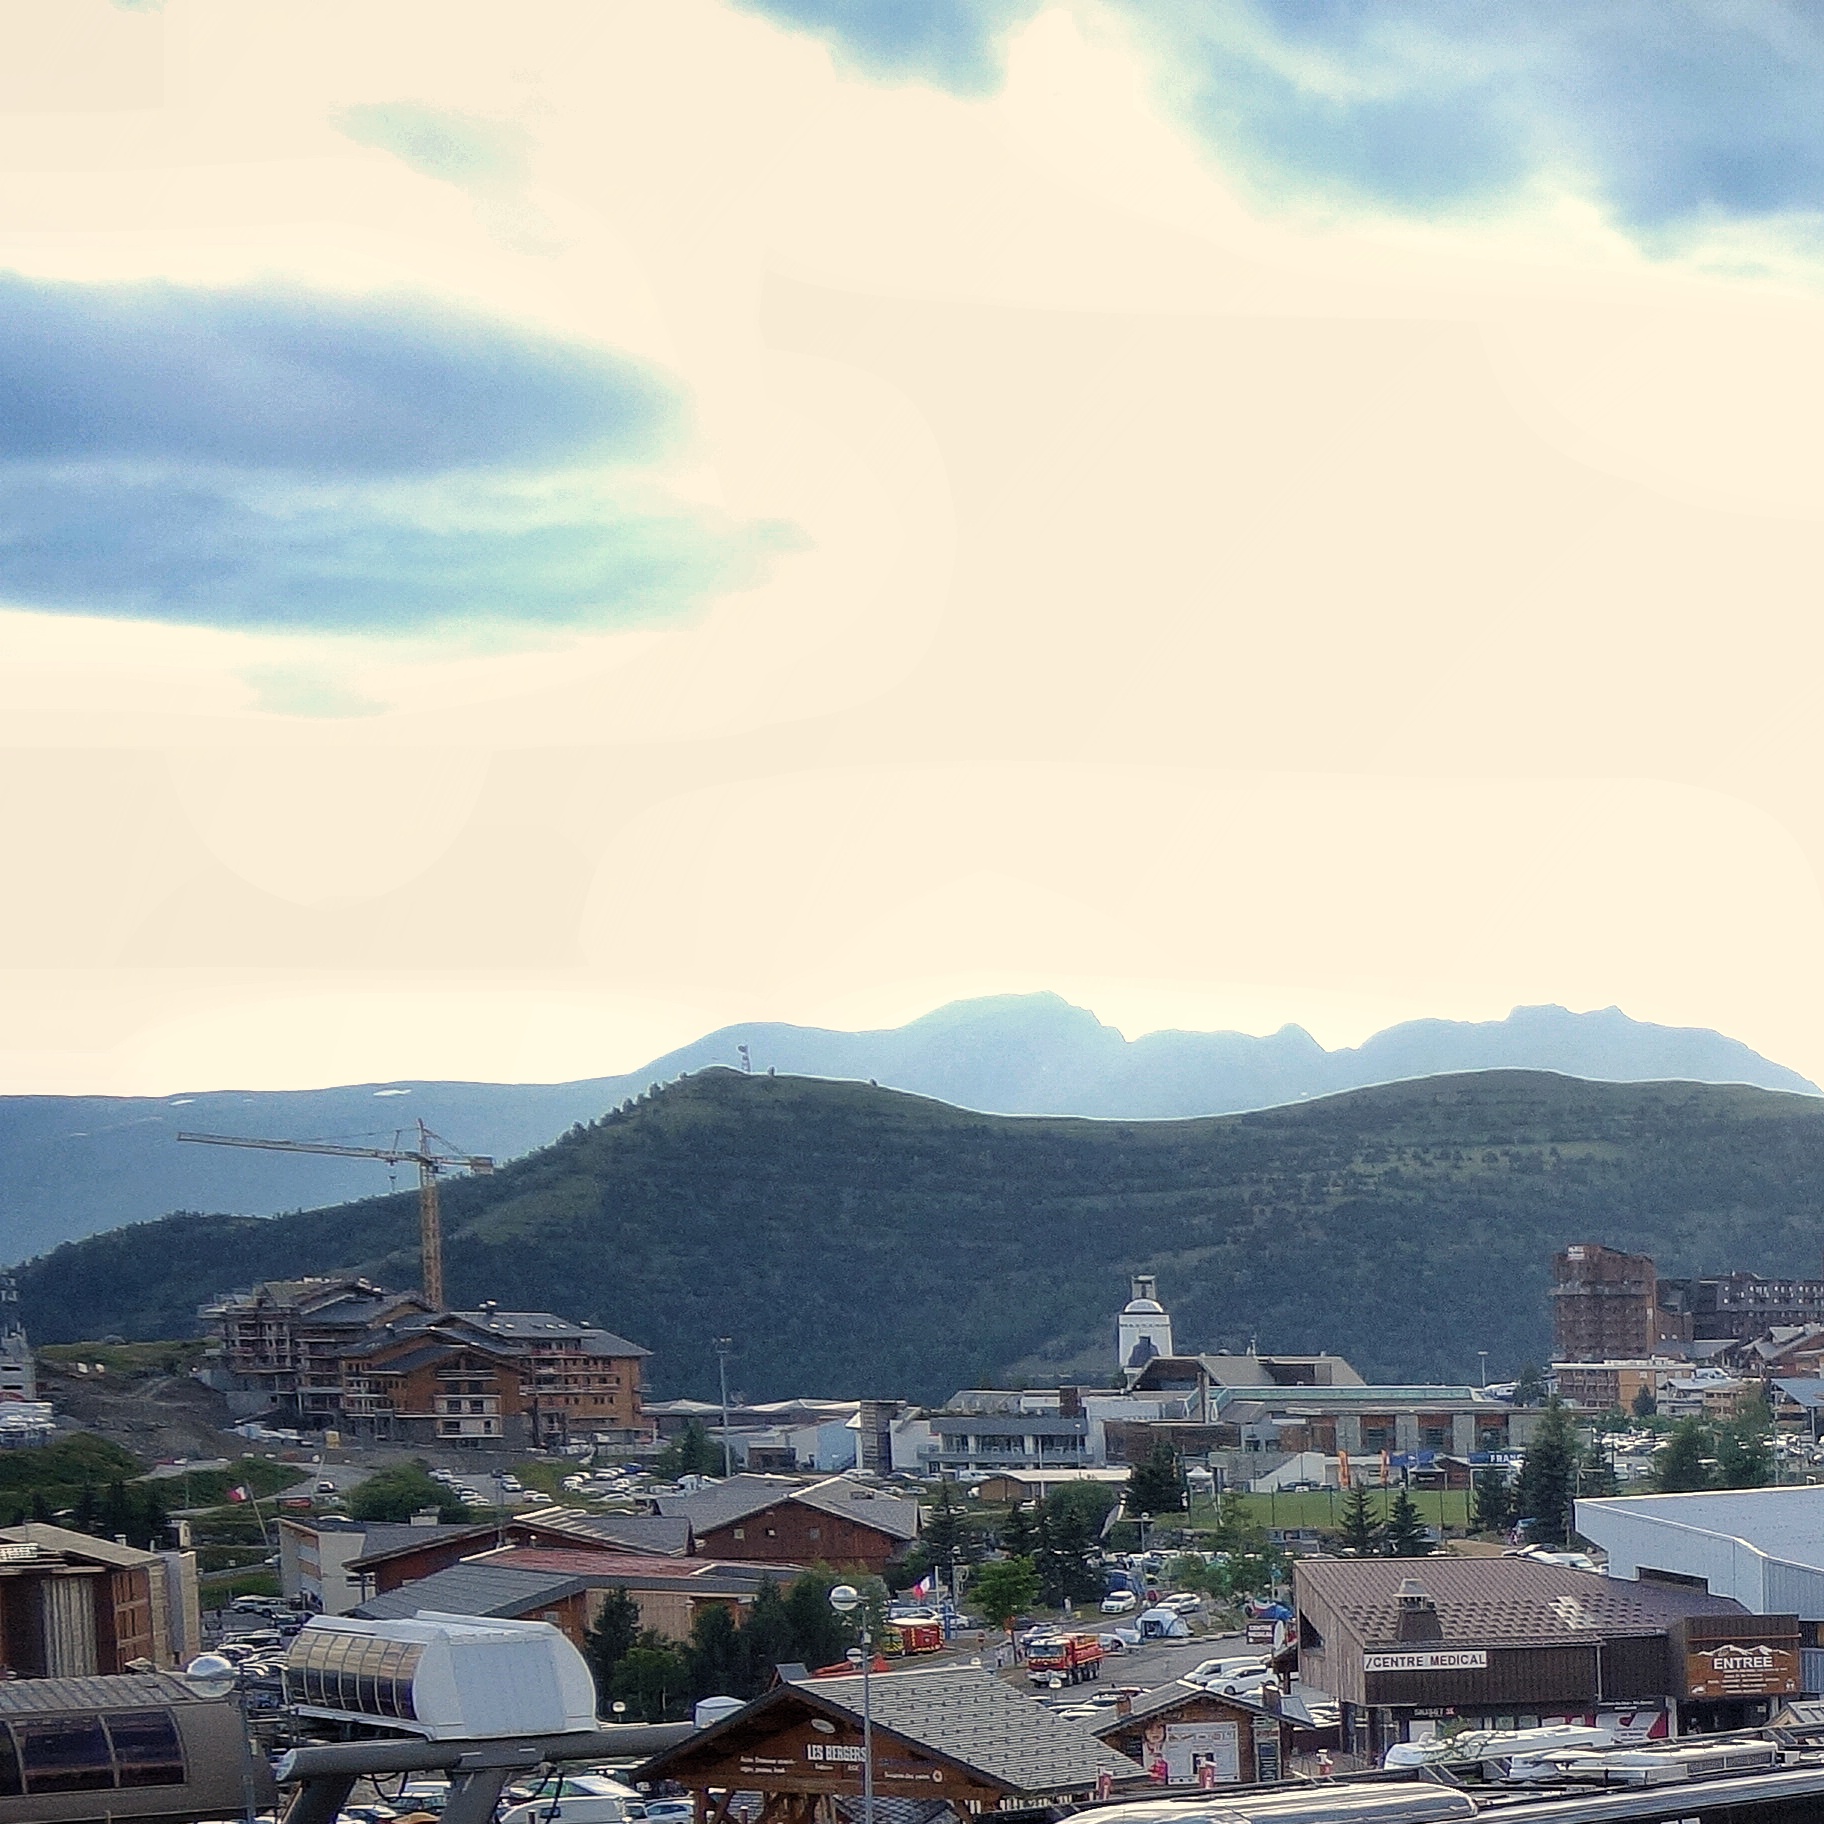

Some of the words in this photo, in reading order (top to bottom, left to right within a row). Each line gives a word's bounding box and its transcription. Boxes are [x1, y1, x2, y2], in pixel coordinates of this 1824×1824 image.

[1430, 1653, 1486, 1667] MEDICAL
[1713, 1656, 1773, 1669] ENTREE
[807, 1744, 823, 1761] LES
[826, 1745, 867, 1763] BERGERS
